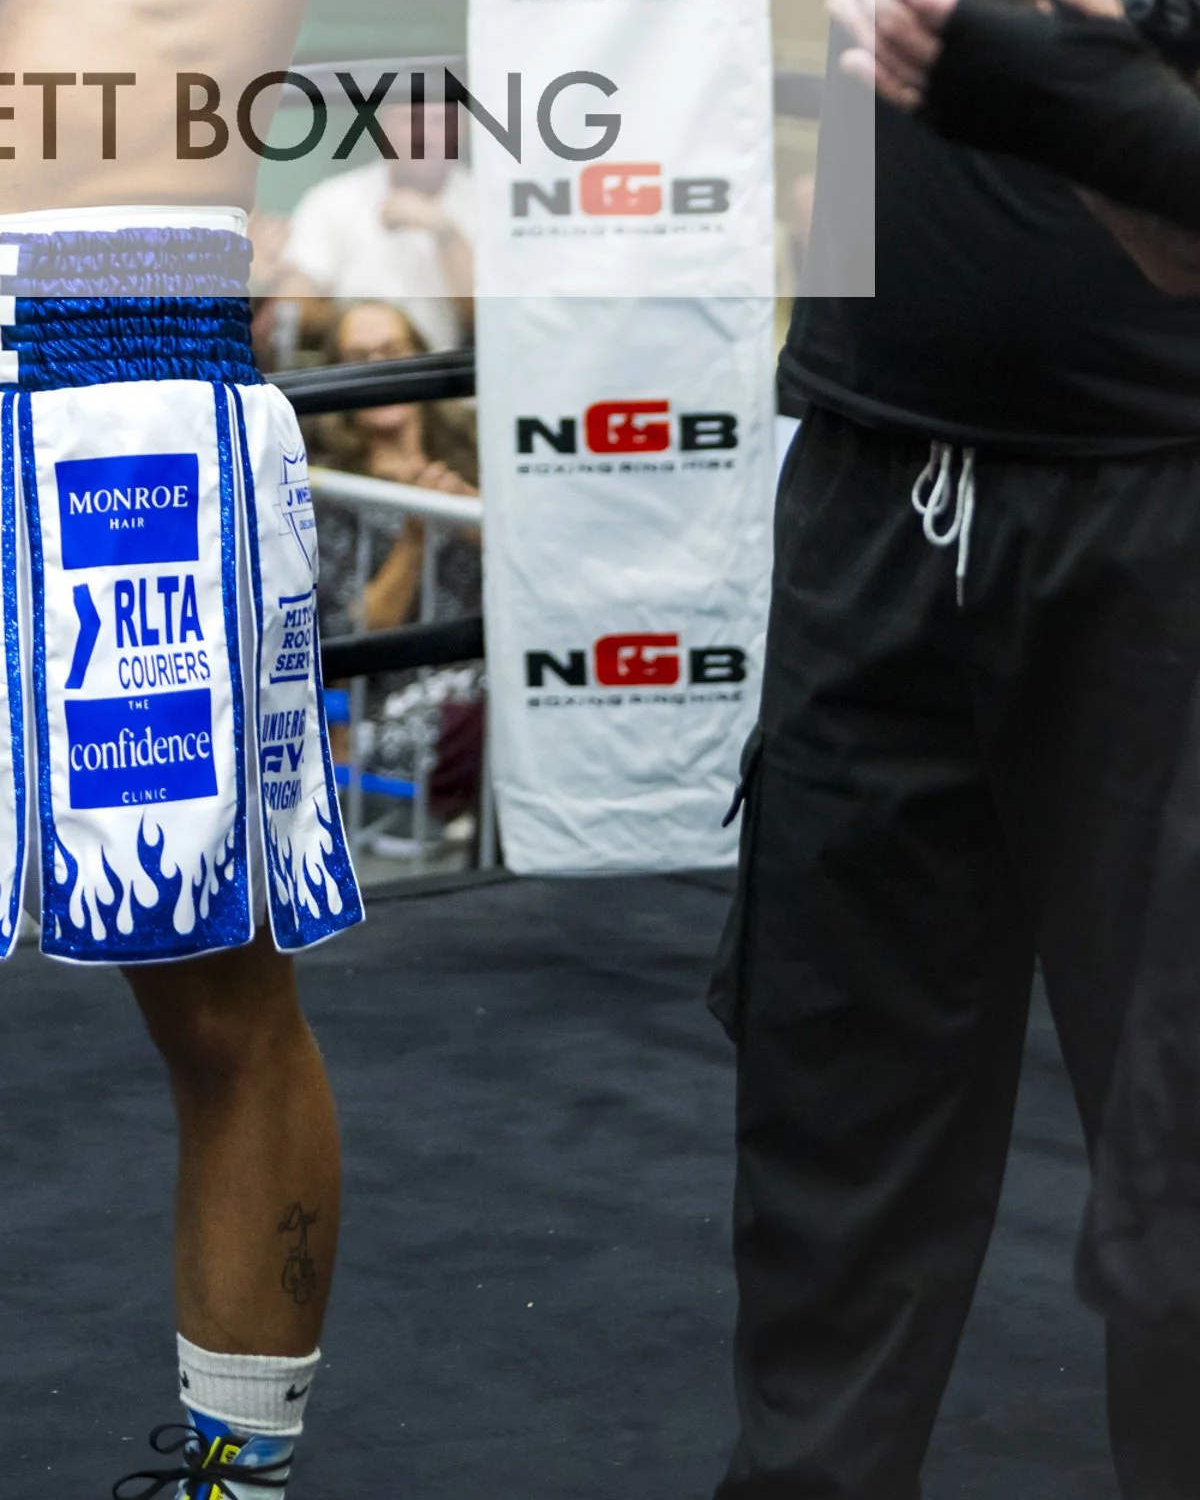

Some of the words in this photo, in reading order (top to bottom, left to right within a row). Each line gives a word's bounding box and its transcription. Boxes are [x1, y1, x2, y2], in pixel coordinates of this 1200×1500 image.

[511, 162, 730, 217] NGB
[517, 398, 738, 454] NGB
[69, 485, 189, 515] MONROE
[109, 517, 145, 530] HAIR
[114, 574, 205, 648] RLTA
[118, 649, 211, 690] COURIERS
[525, 632, 747, 688] NGB
[127, 699, 150, 710] THE
[70, 725, 211, 772] confidence
[121, 787, 168, 803] CLINIC
